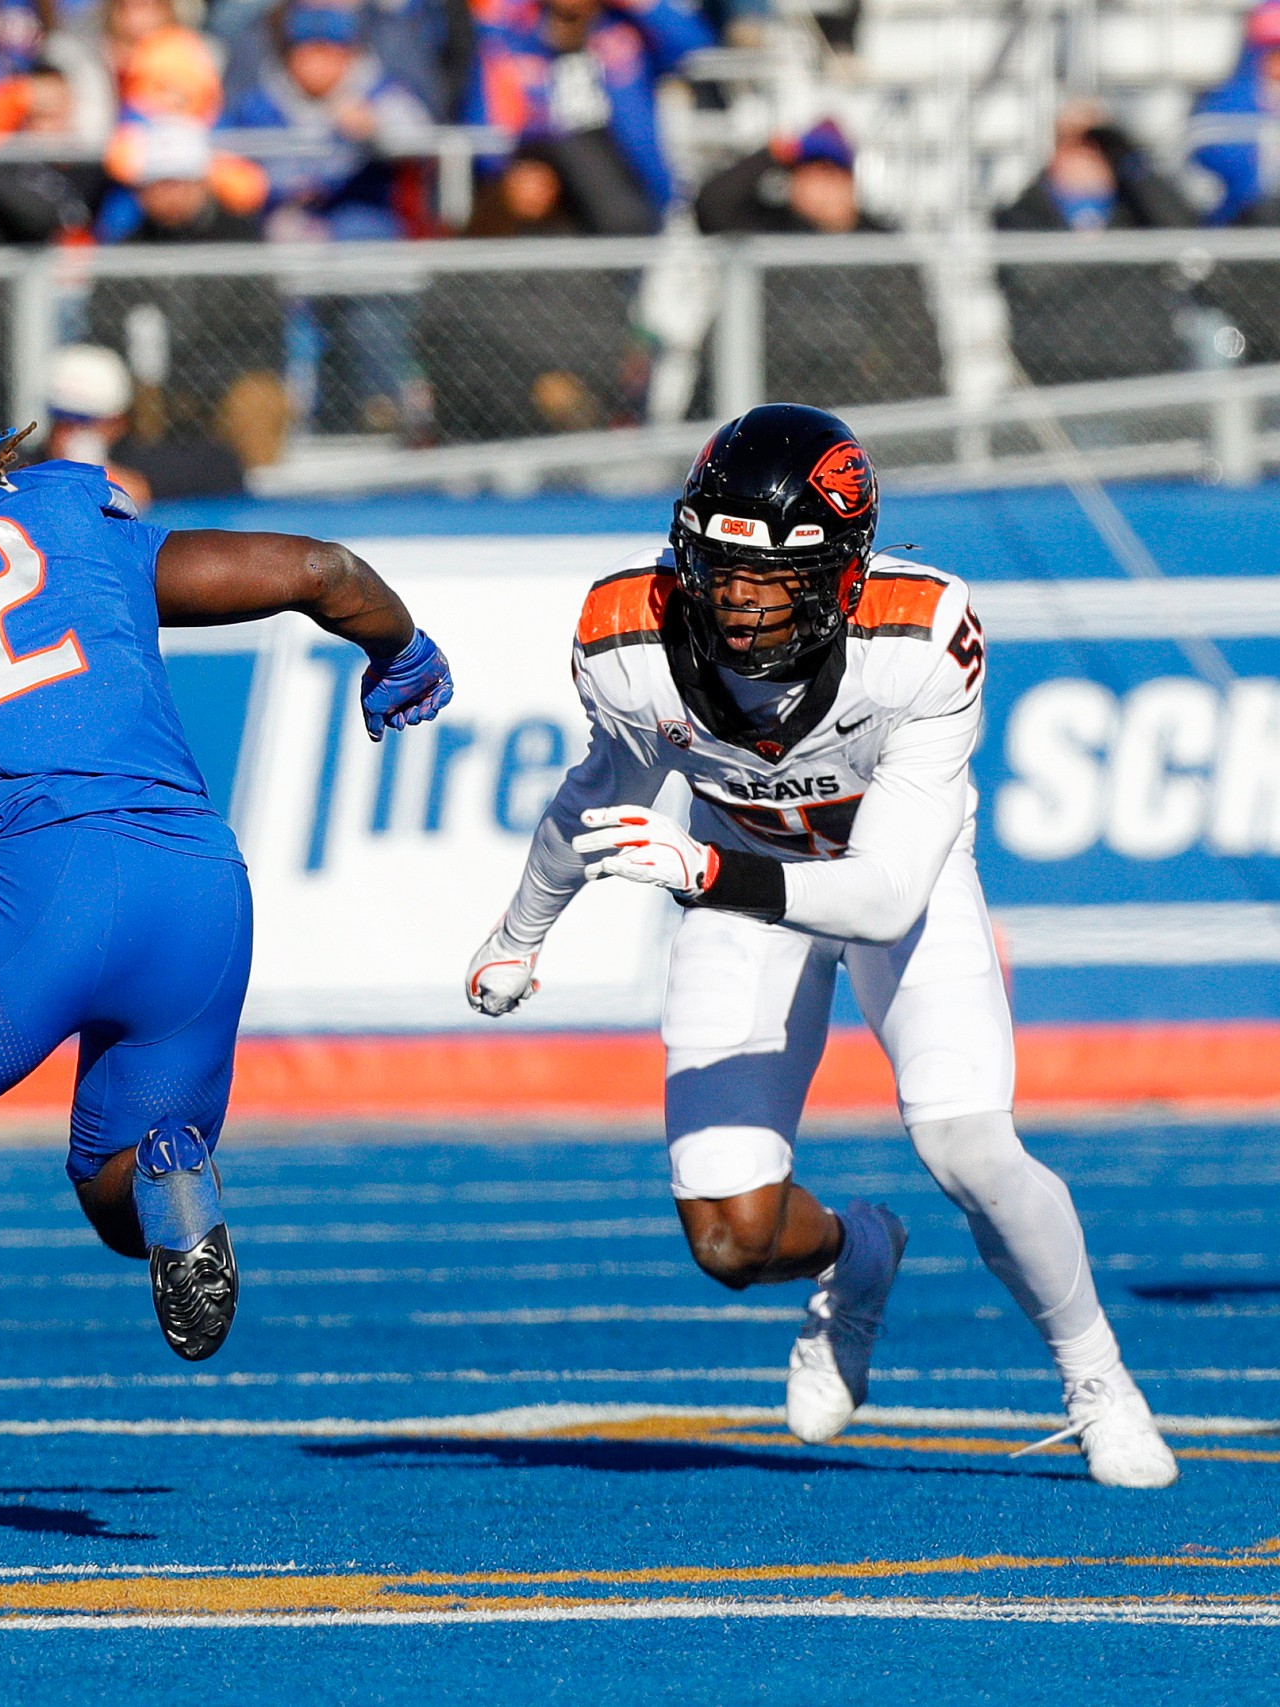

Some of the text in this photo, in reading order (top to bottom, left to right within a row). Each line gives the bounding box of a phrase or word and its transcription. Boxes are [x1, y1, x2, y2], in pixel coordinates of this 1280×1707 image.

[721, 518, 755, 537] OSU
[946, 605, 984, 693] 5
[305, 642, 566, 873] Tire
[725, 775, 840, 800] BEAVS
